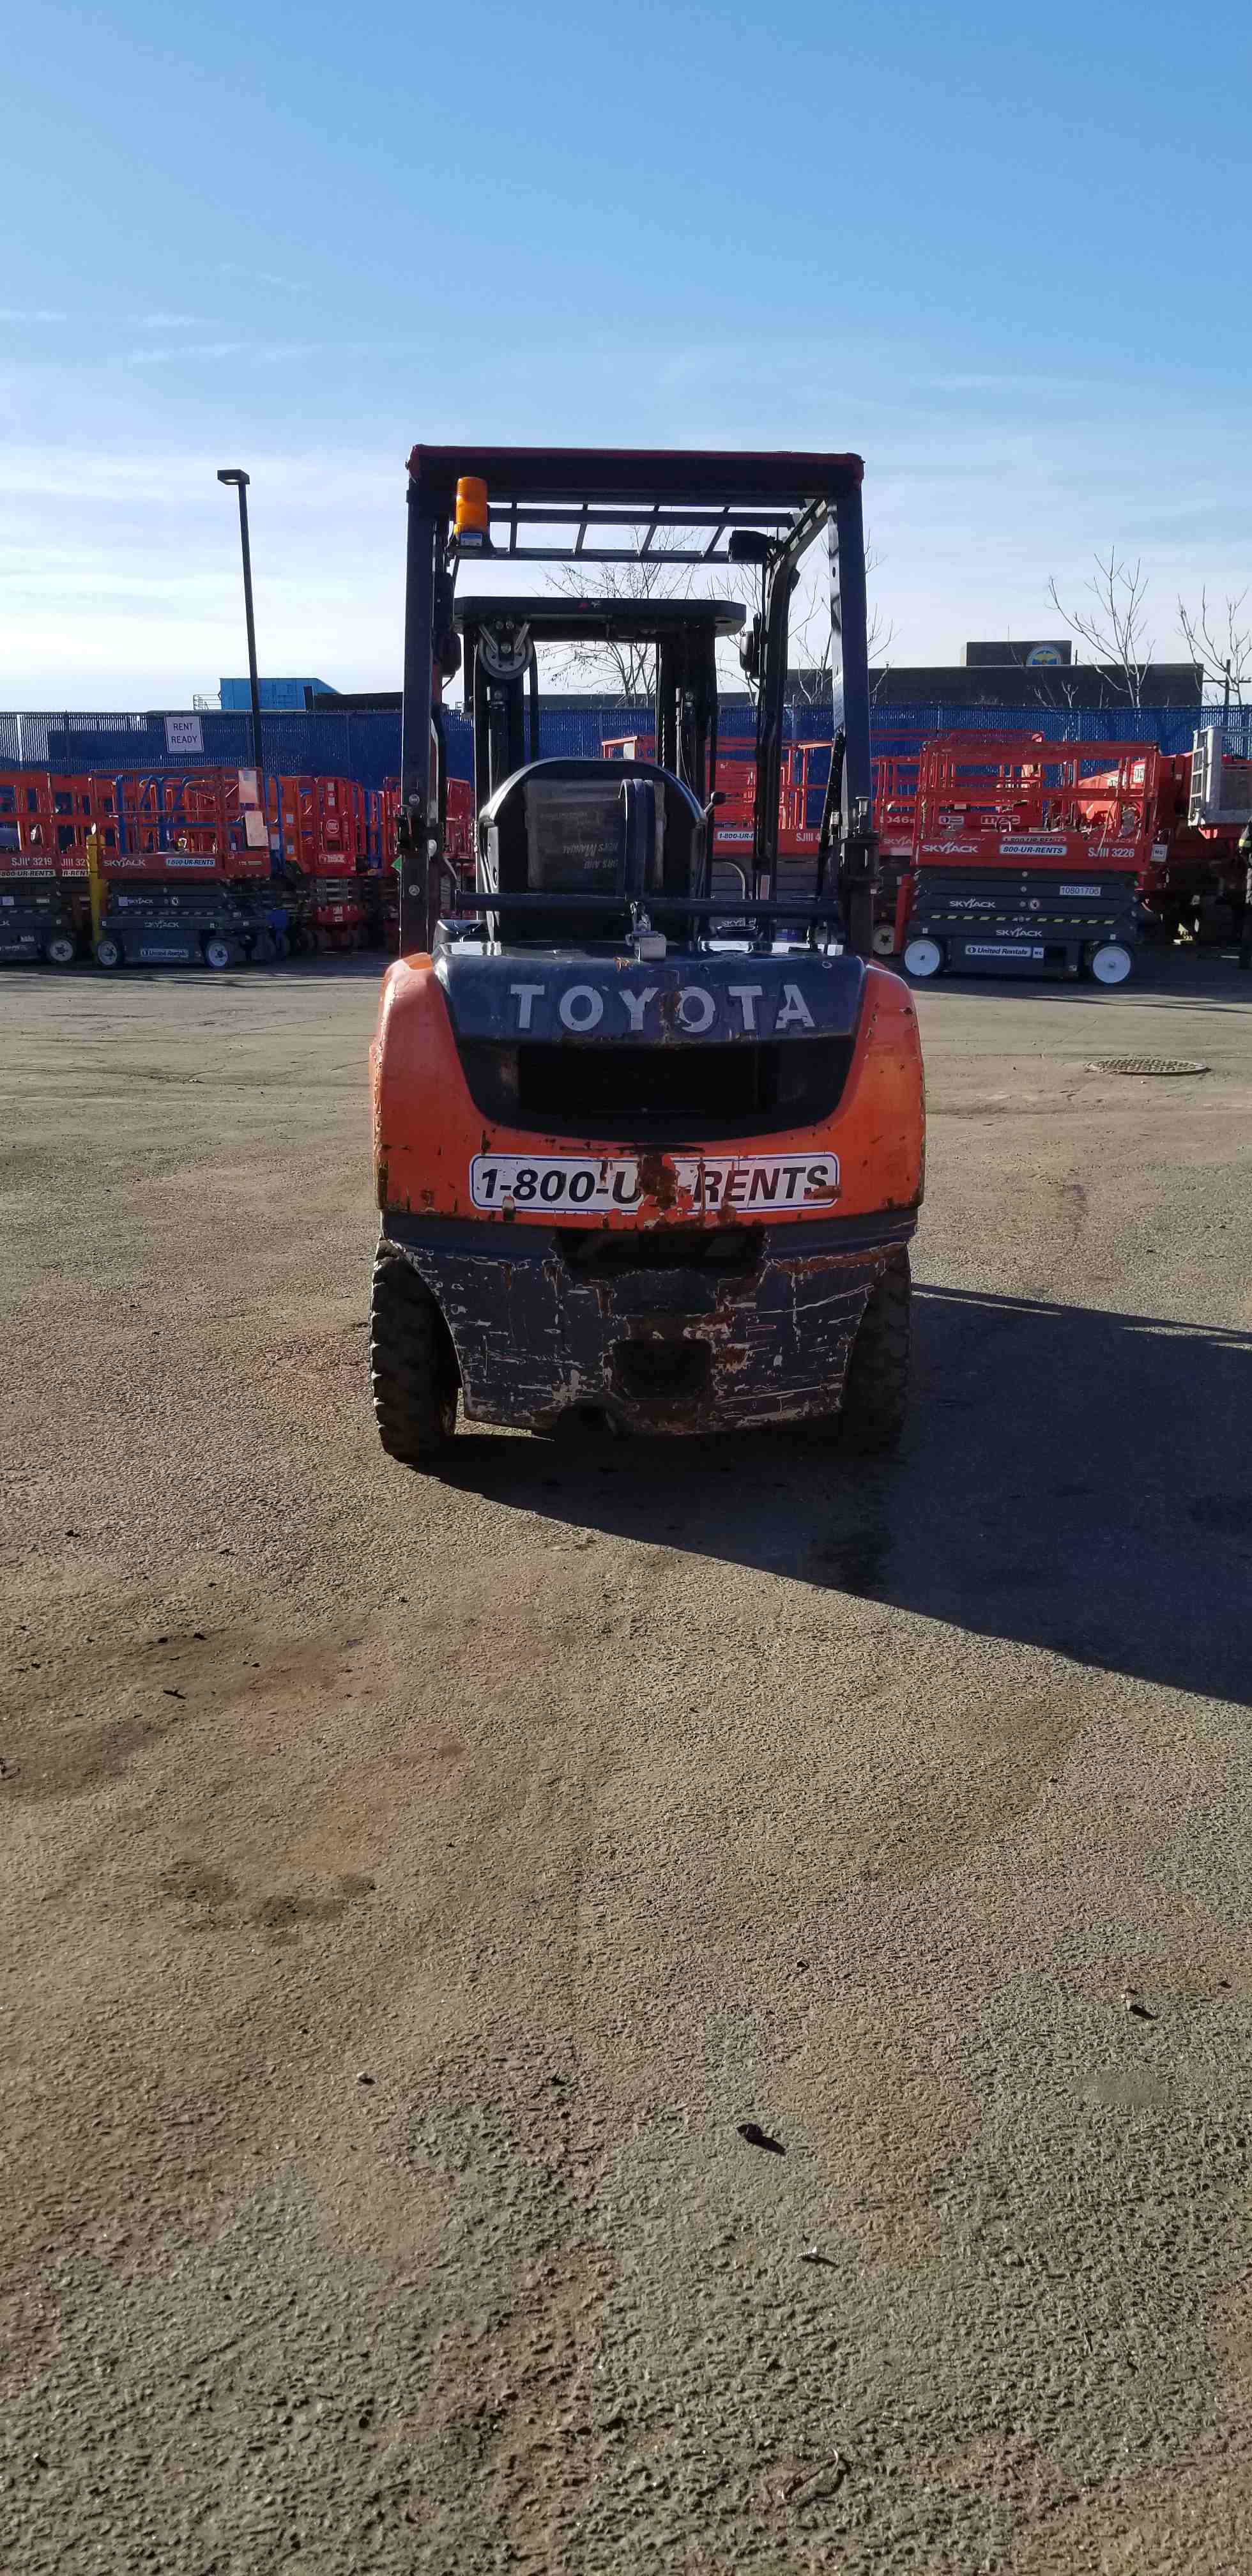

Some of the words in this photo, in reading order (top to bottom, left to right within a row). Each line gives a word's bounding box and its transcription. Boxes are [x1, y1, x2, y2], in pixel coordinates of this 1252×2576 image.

[173, 723, 194, 731] RENT
[171, 735, 197, 744] READY
[922, 841, 979, 854] SKYJACK
[1111, 848, 1135, 857] 3226
[33, 857, 52, 866] 3219
[103, 857, 146, 868] SKYJACK
[949, 898, 996, 908] SKYJACK
[996, 927, 1042, 937] SKYJACK
[510, 983, 817, 1033] TOYOTA
